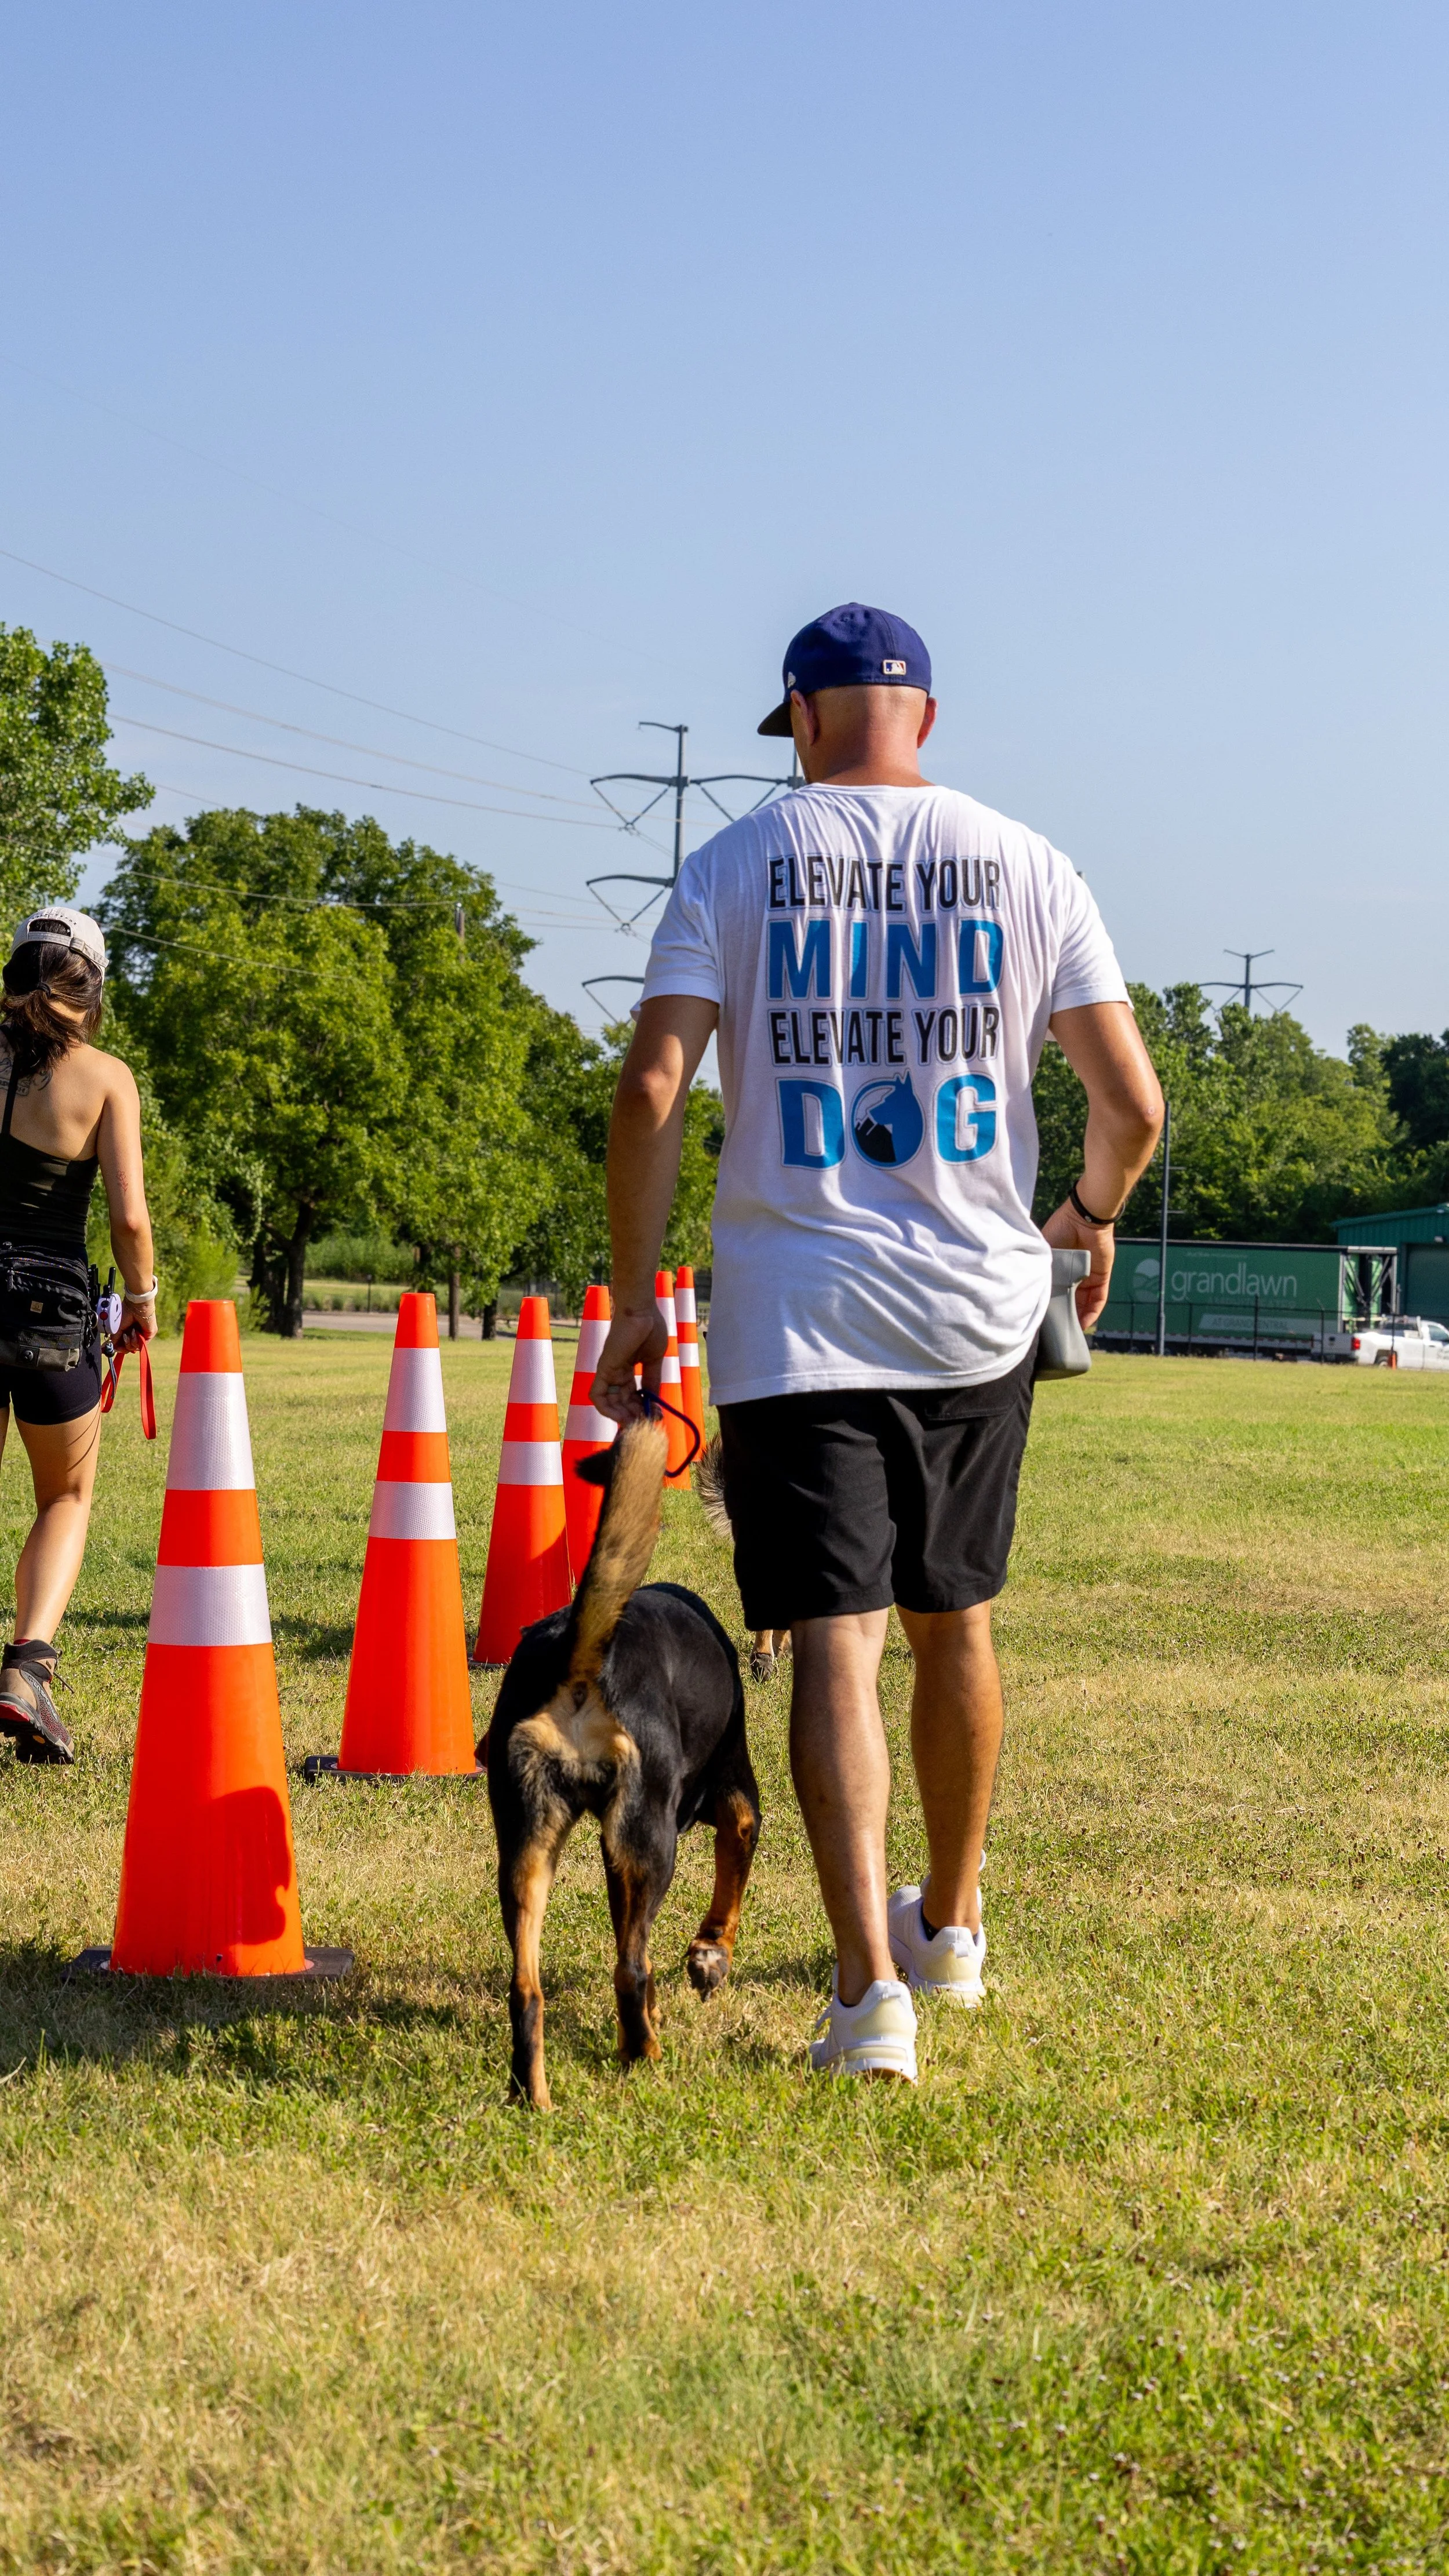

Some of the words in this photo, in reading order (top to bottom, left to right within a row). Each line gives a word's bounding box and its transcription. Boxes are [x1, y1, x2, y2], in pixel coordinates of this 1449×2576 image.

[769, 856, 904, 911] ELEVATE
[916, 858, 1001, 911] YOUR
[769, 919, 1004, 999] MIND
[770, 1010, 906, 1064] ELEVATE
[915, 1006, 1000, 1063] YOUR
[778, 1071, 997, 1169] DOG
[1171, 1261, 1298, 1301] grandlawn
